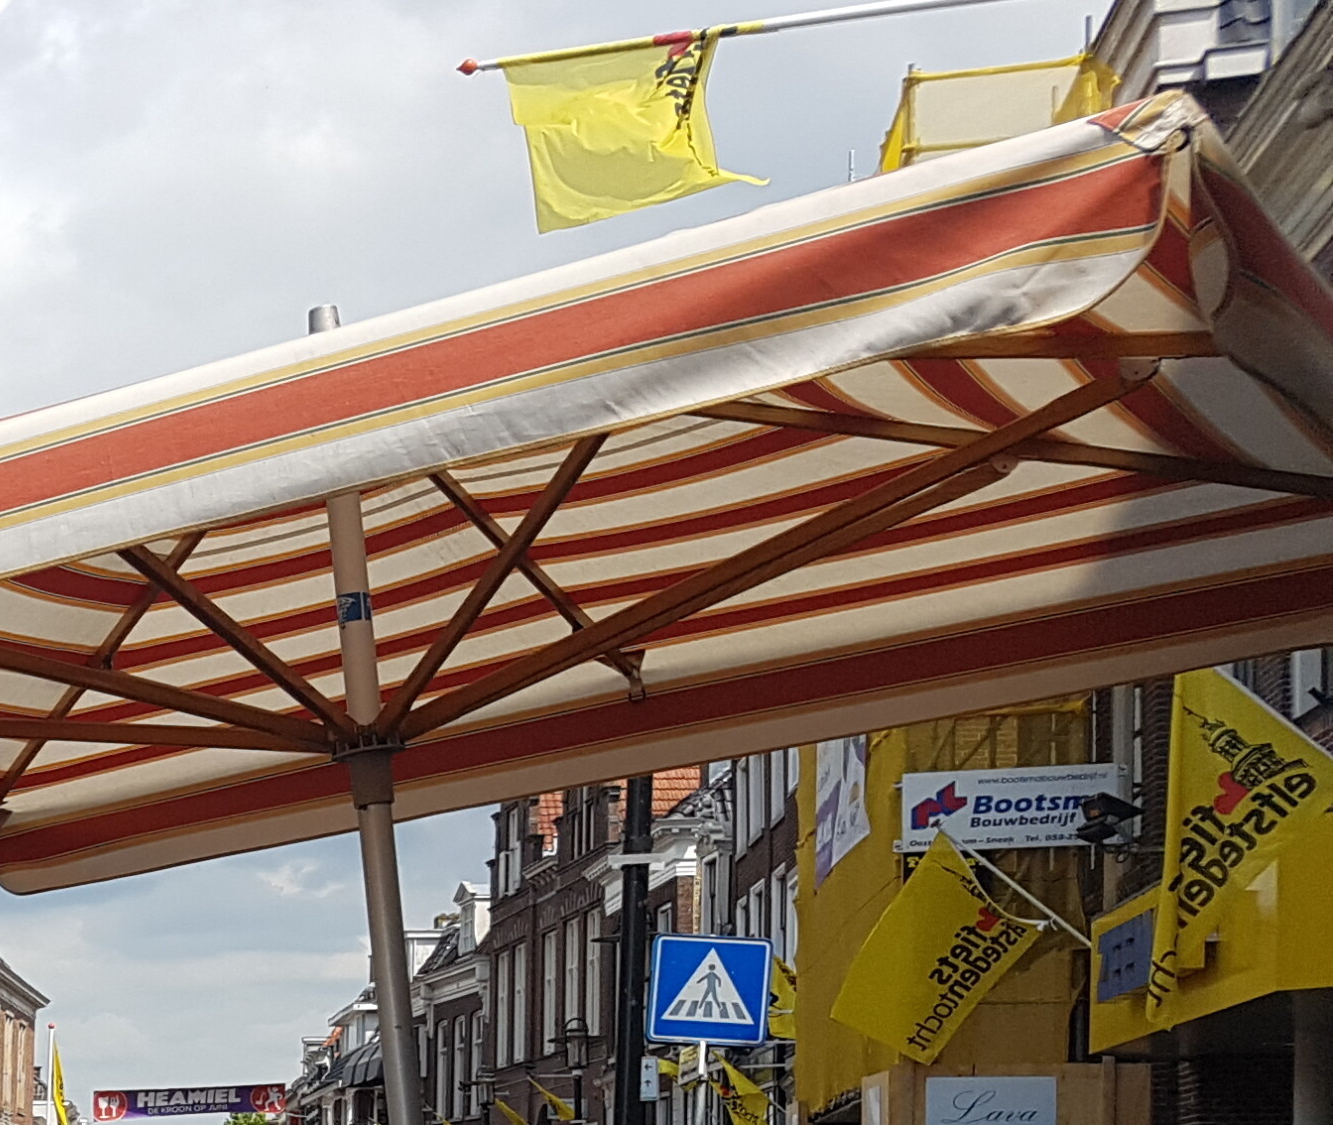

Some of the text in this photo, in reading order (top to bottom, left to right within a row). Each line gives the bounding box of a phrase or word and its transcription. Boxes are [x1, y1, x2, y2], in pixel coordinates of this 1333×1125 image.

[972, 793, 1090, 815] Bootsm
[969, 811, 1077, 829] Bouwbedrijf
[136, 1087, 241, 1109] HEAMIEL
[940, 1090, 1038, 1125] Lava
[147, 1106, 159, 1115] DE
[160, 1105, 192, 1115] KROON
[193, 1104, 207, 1113] OP
